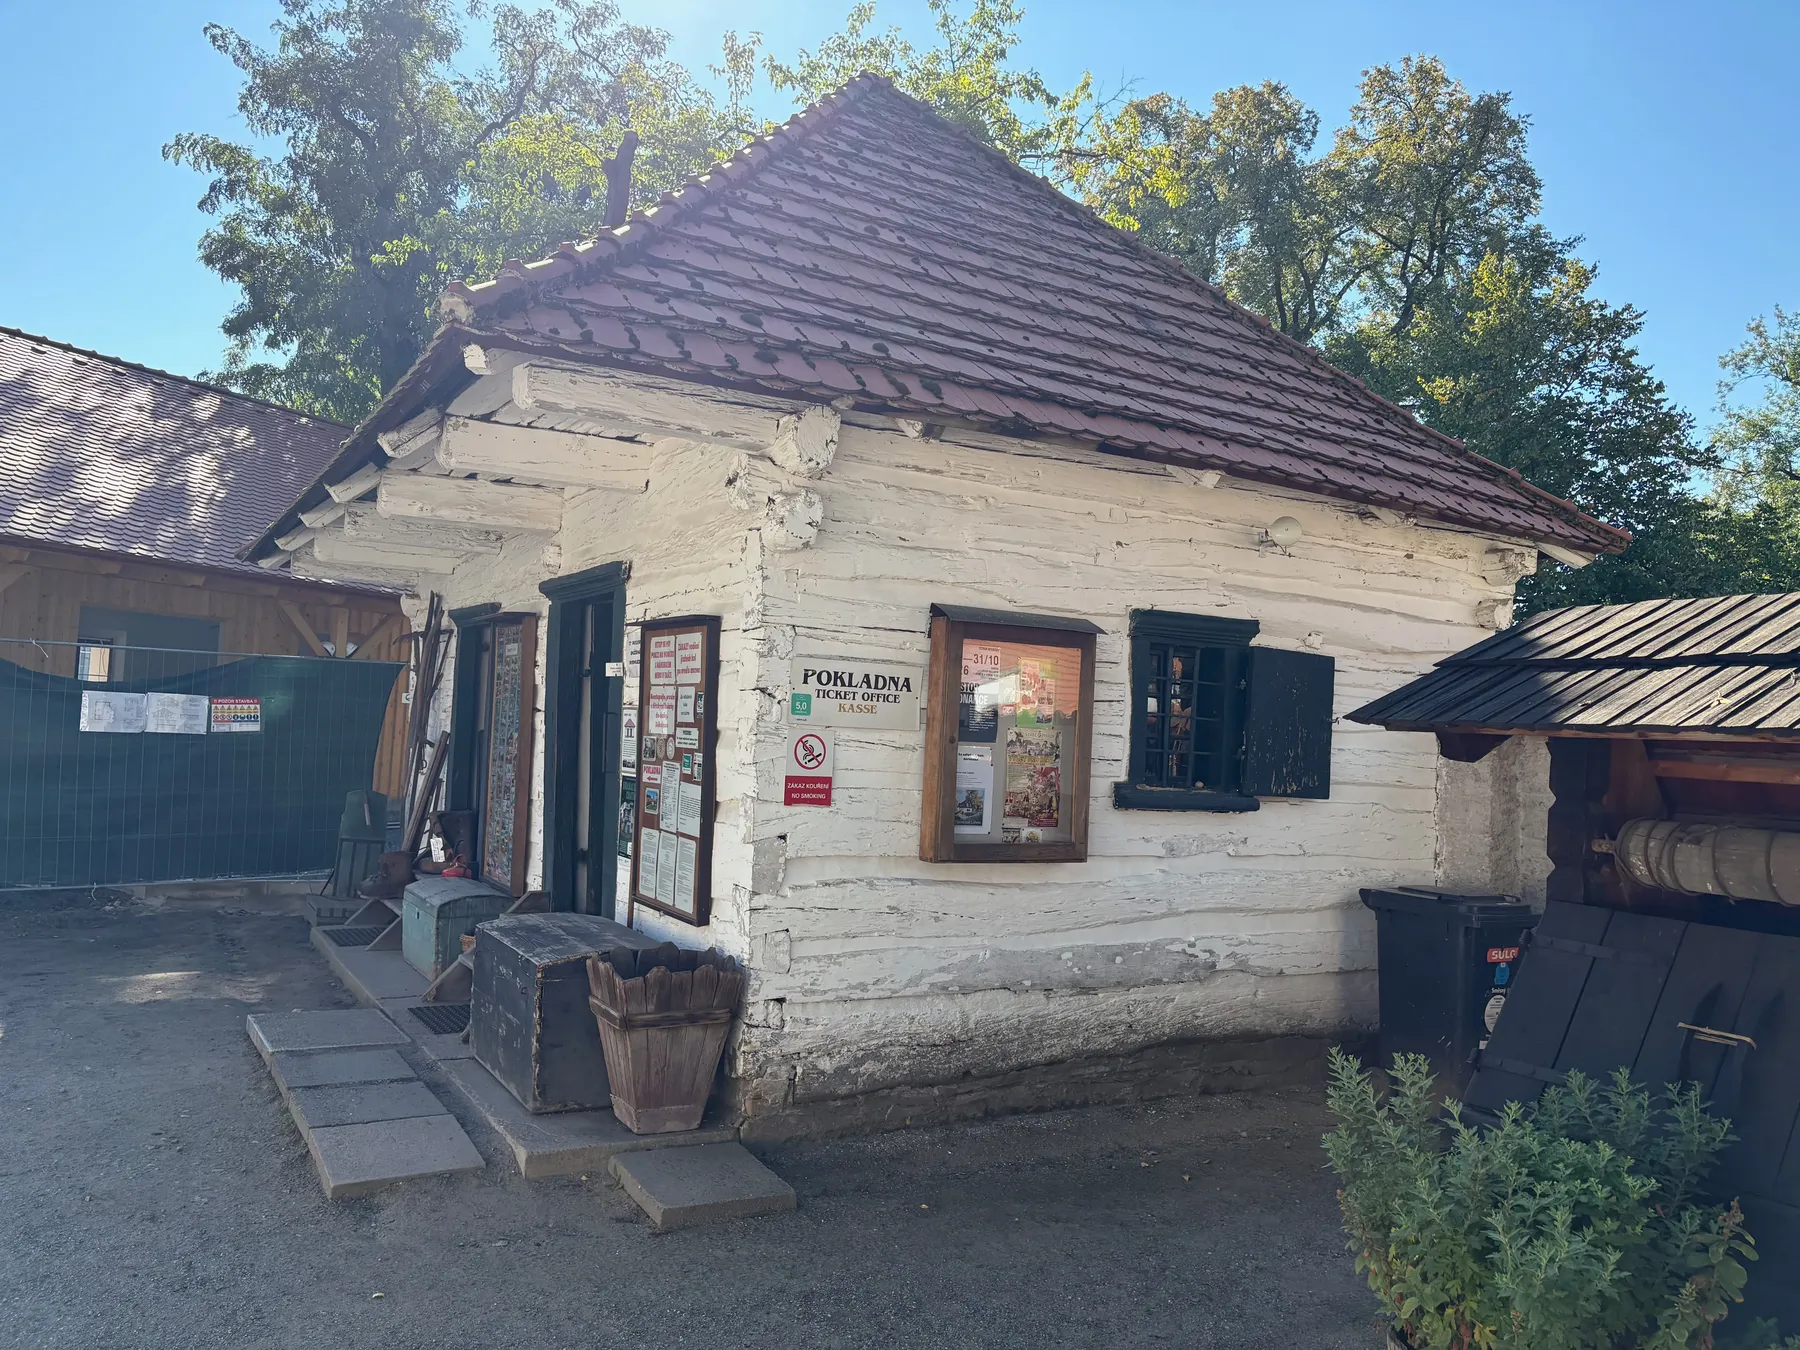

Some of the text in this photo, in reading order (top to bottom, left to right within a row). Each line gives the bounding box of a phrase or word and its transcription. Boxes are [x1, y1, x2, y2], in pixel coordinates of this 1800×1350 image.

[802, 668, 912, 692] POKLADNA
[815, 689, 901, 703] TICKET OFFICE
[838, 703, 878, 714] KASSE
